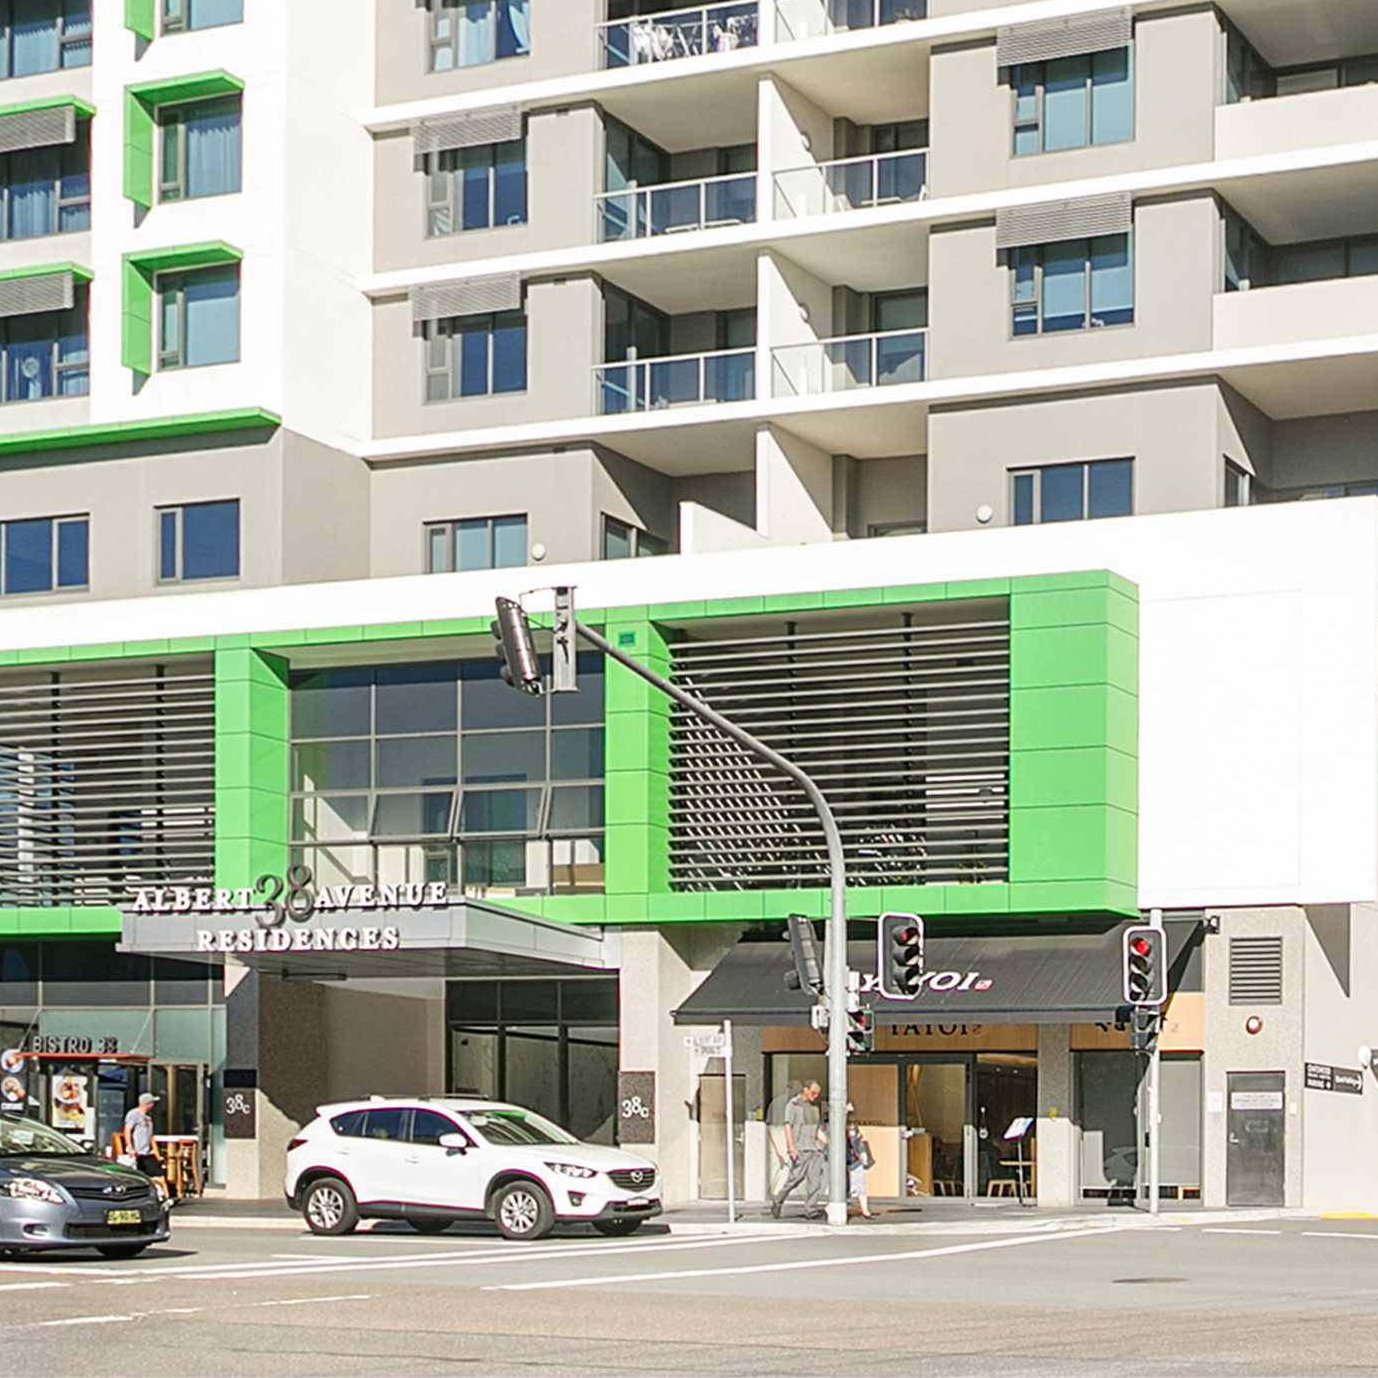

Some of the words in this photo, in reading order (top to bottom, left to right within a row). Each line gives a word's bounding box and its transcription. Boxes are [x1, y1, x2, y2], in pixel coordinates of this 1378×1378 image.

[132, 887, 254, 912] ALBERT
[255, 864, 315, 929] 38
[314, 881, 448, 909] AVENUE
[197, 926, 400, 952] RESIDENCES
[33, 1036, 91, 1053] BISTRO
